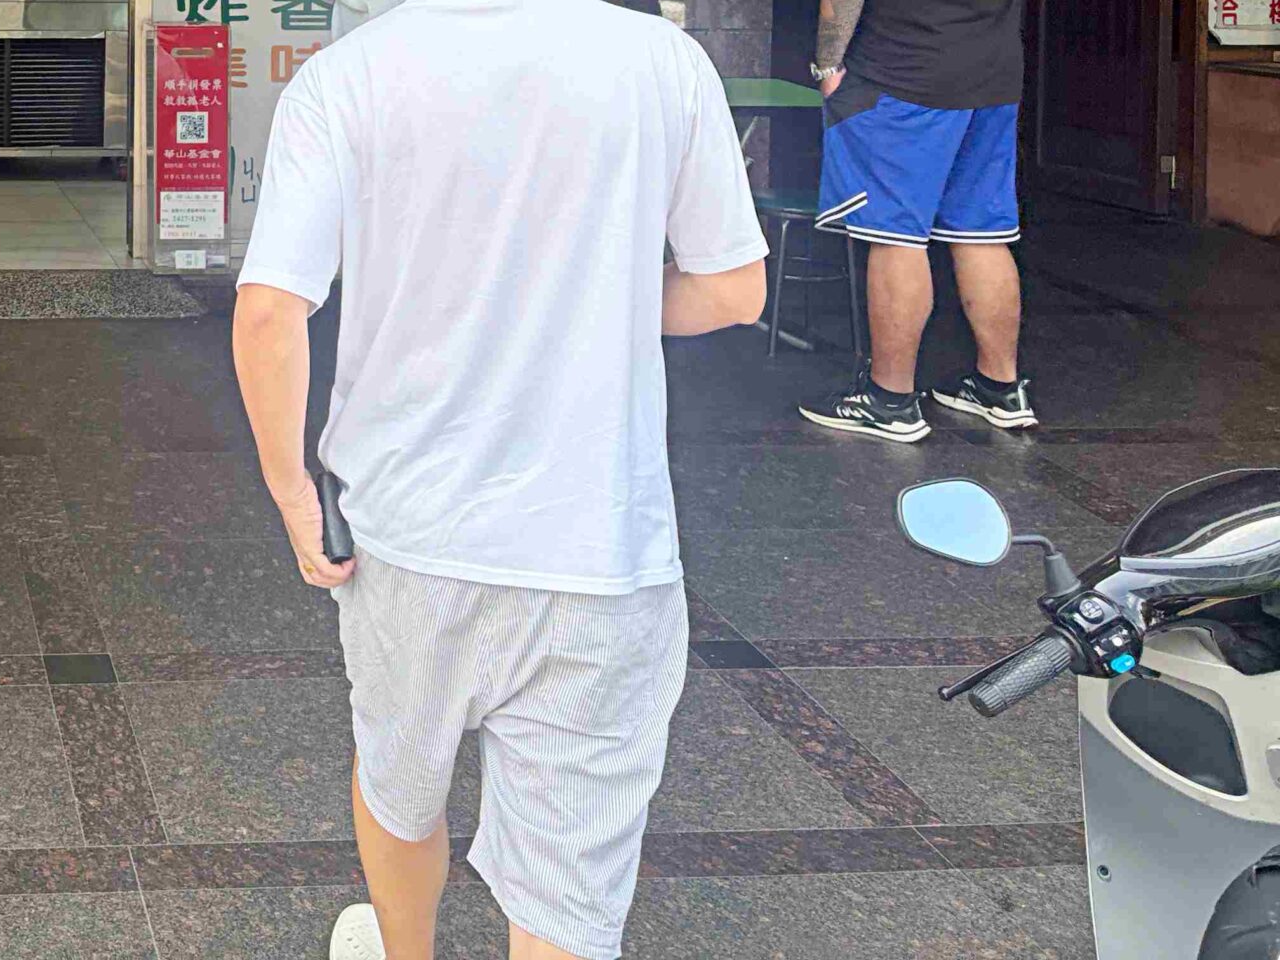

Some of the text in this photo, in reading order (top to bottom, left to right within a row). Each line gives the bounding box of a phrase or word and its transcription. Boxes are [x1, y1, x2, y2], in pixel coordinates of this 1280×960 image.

[163, 149, 222, 159] 華山基金會
